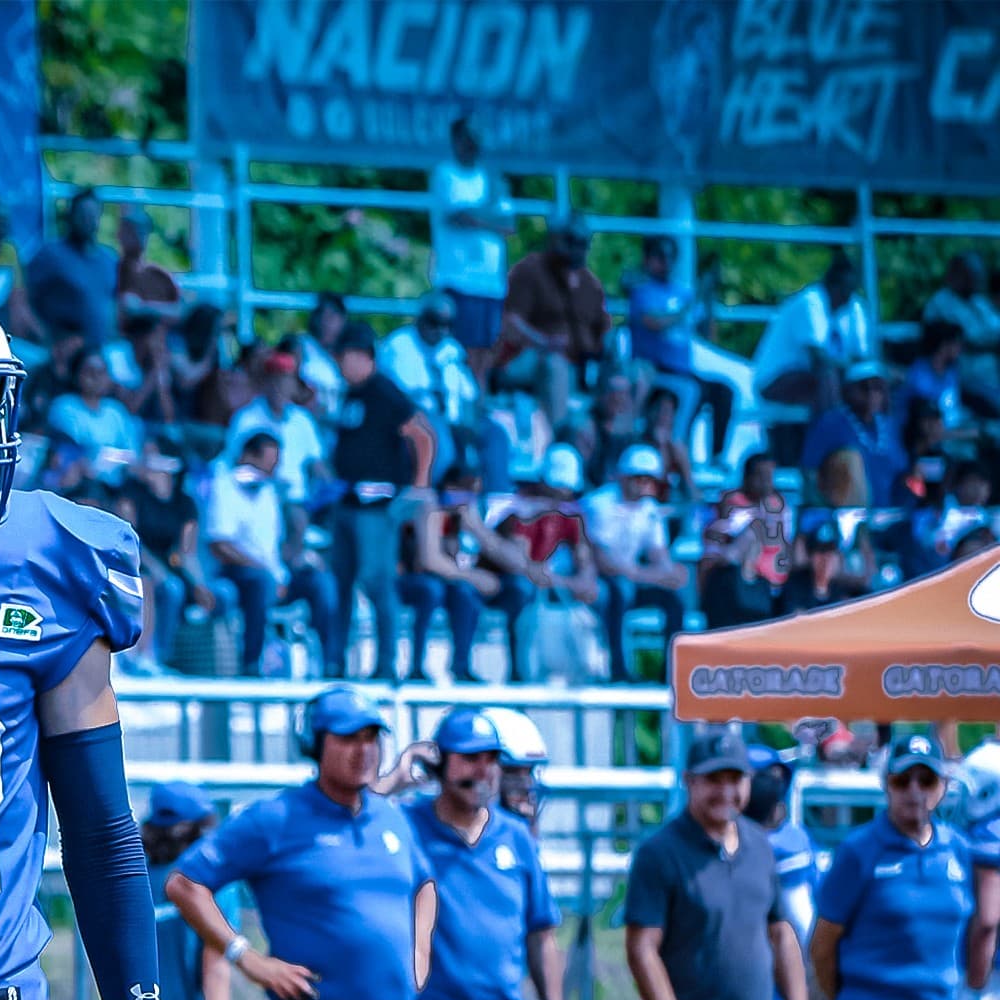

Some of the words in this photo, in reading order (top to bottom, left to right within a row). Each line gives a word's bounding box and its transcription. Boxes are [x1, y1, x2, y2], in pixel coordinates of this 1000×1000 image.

[243, 0, 592, 98] NACION
[731, 0, 897, 60] BLUE
[928, 27, 1000, 122] C
[718, 62, 920, 163] HEART
[882, 664, 1000, 697] GATORA
